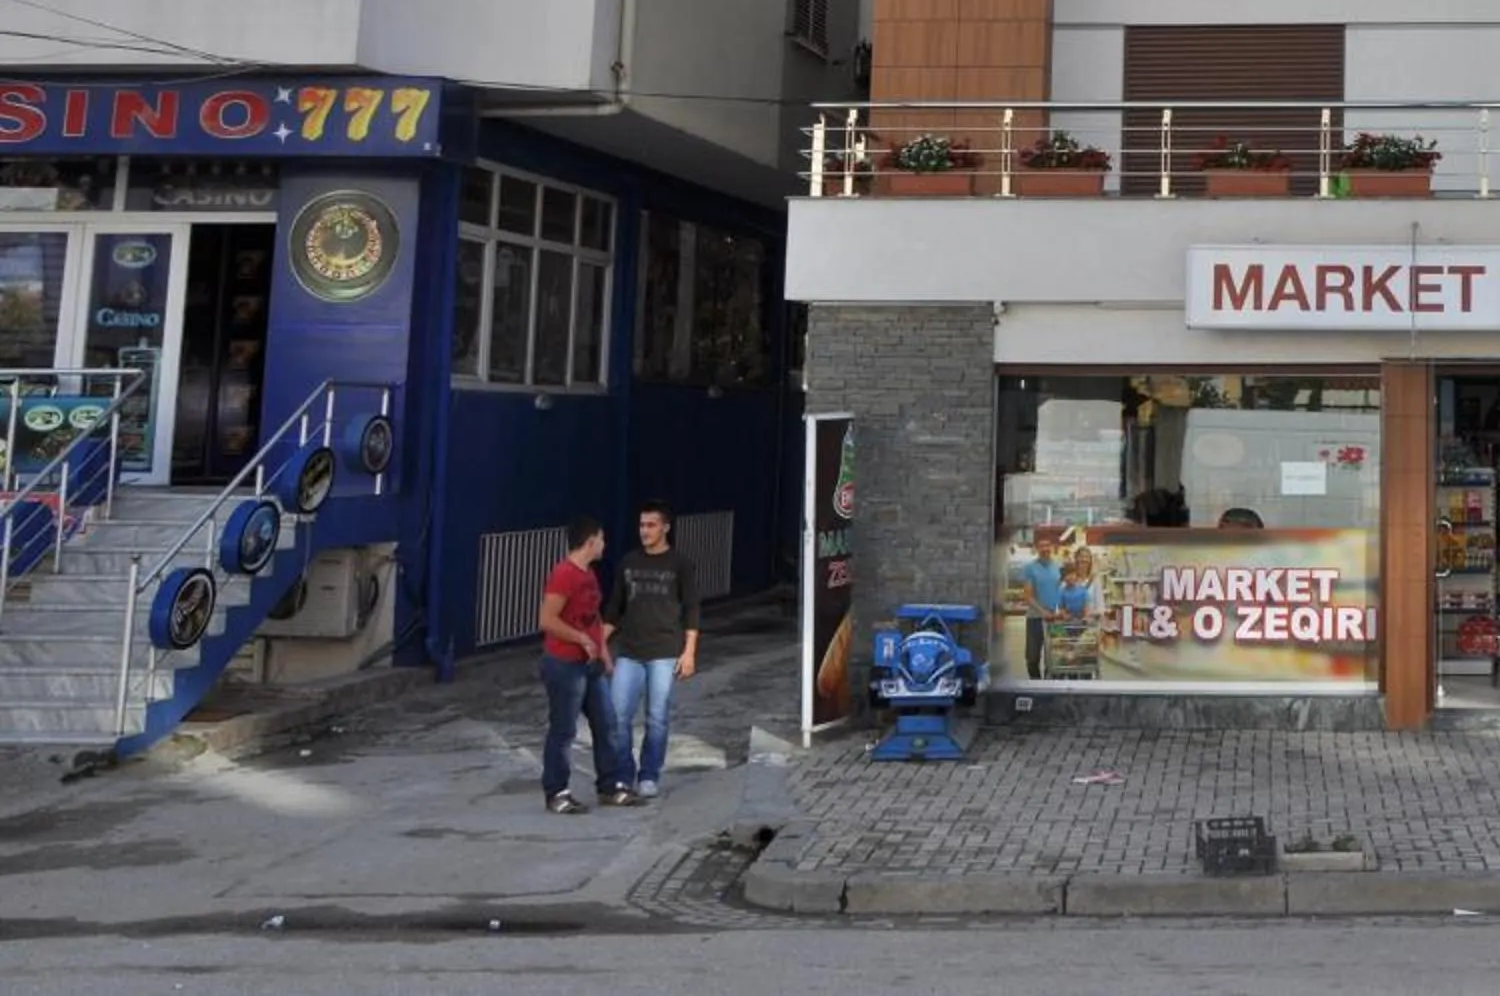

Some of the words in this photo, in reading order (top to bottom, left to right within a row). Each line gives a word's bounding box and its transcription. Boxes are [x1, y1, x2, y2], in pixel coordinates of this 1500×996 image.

[0, 81, 272, 143] SINO
[297, 85, 431, 142] 777
[1211, 263, 1486, 313] MARKET
[1162, 567, 1341, 603] MARKET
[1121, 605, 1134, 639] I
[1149, 605, 1178, 640] &
[1193, 605, 1225, 640] O
[1235, 606, 1378, 642] ZEQIRI
